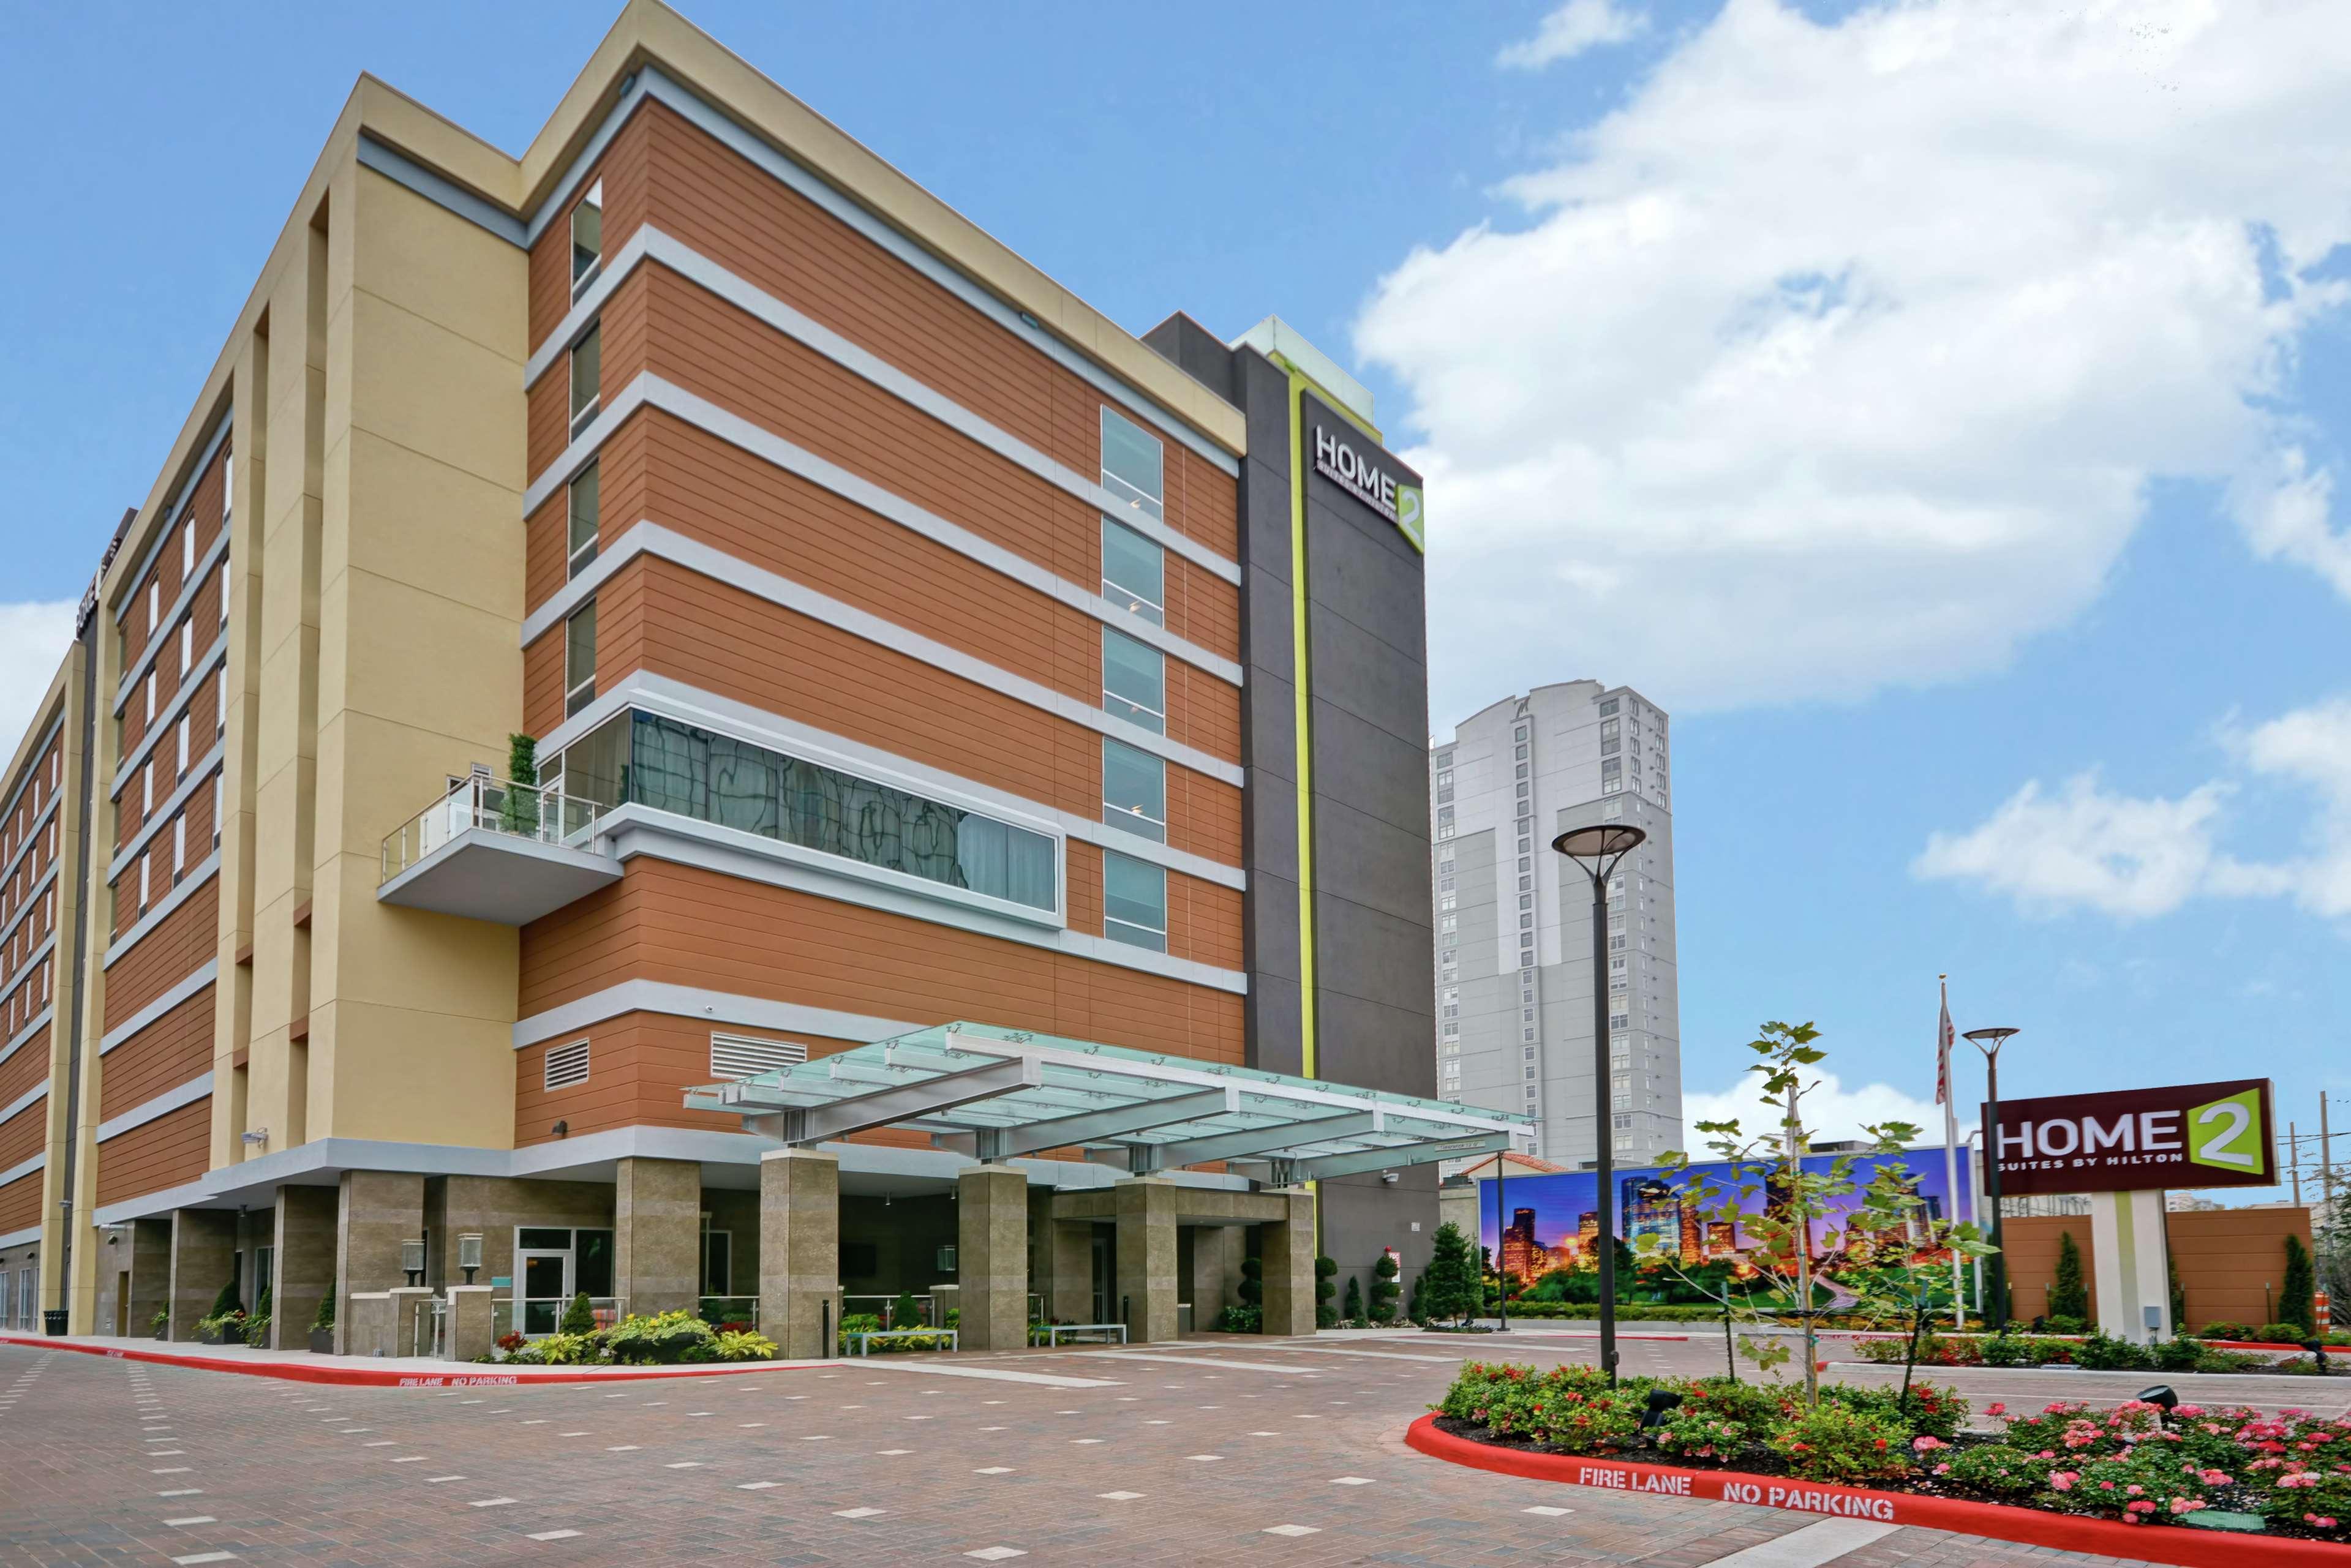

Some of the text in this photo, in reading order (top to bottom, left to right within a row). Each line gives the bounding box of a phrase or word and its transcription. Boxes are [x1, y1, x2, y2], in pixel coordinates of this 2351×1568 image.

[1316, 424, 1421, 544] HOME 2
[1996, 1101, 2254, 1166] HOME 2
[1998, 1153, 2183, 1172] SUITES BY HILTON
[399, 1376, 517, 1387] FIRE LANE NO PARKING
[1579, 1467, 1692, 1496] FIRE LANE
[1723, 1482, 1894, 1520] NO PARKING
